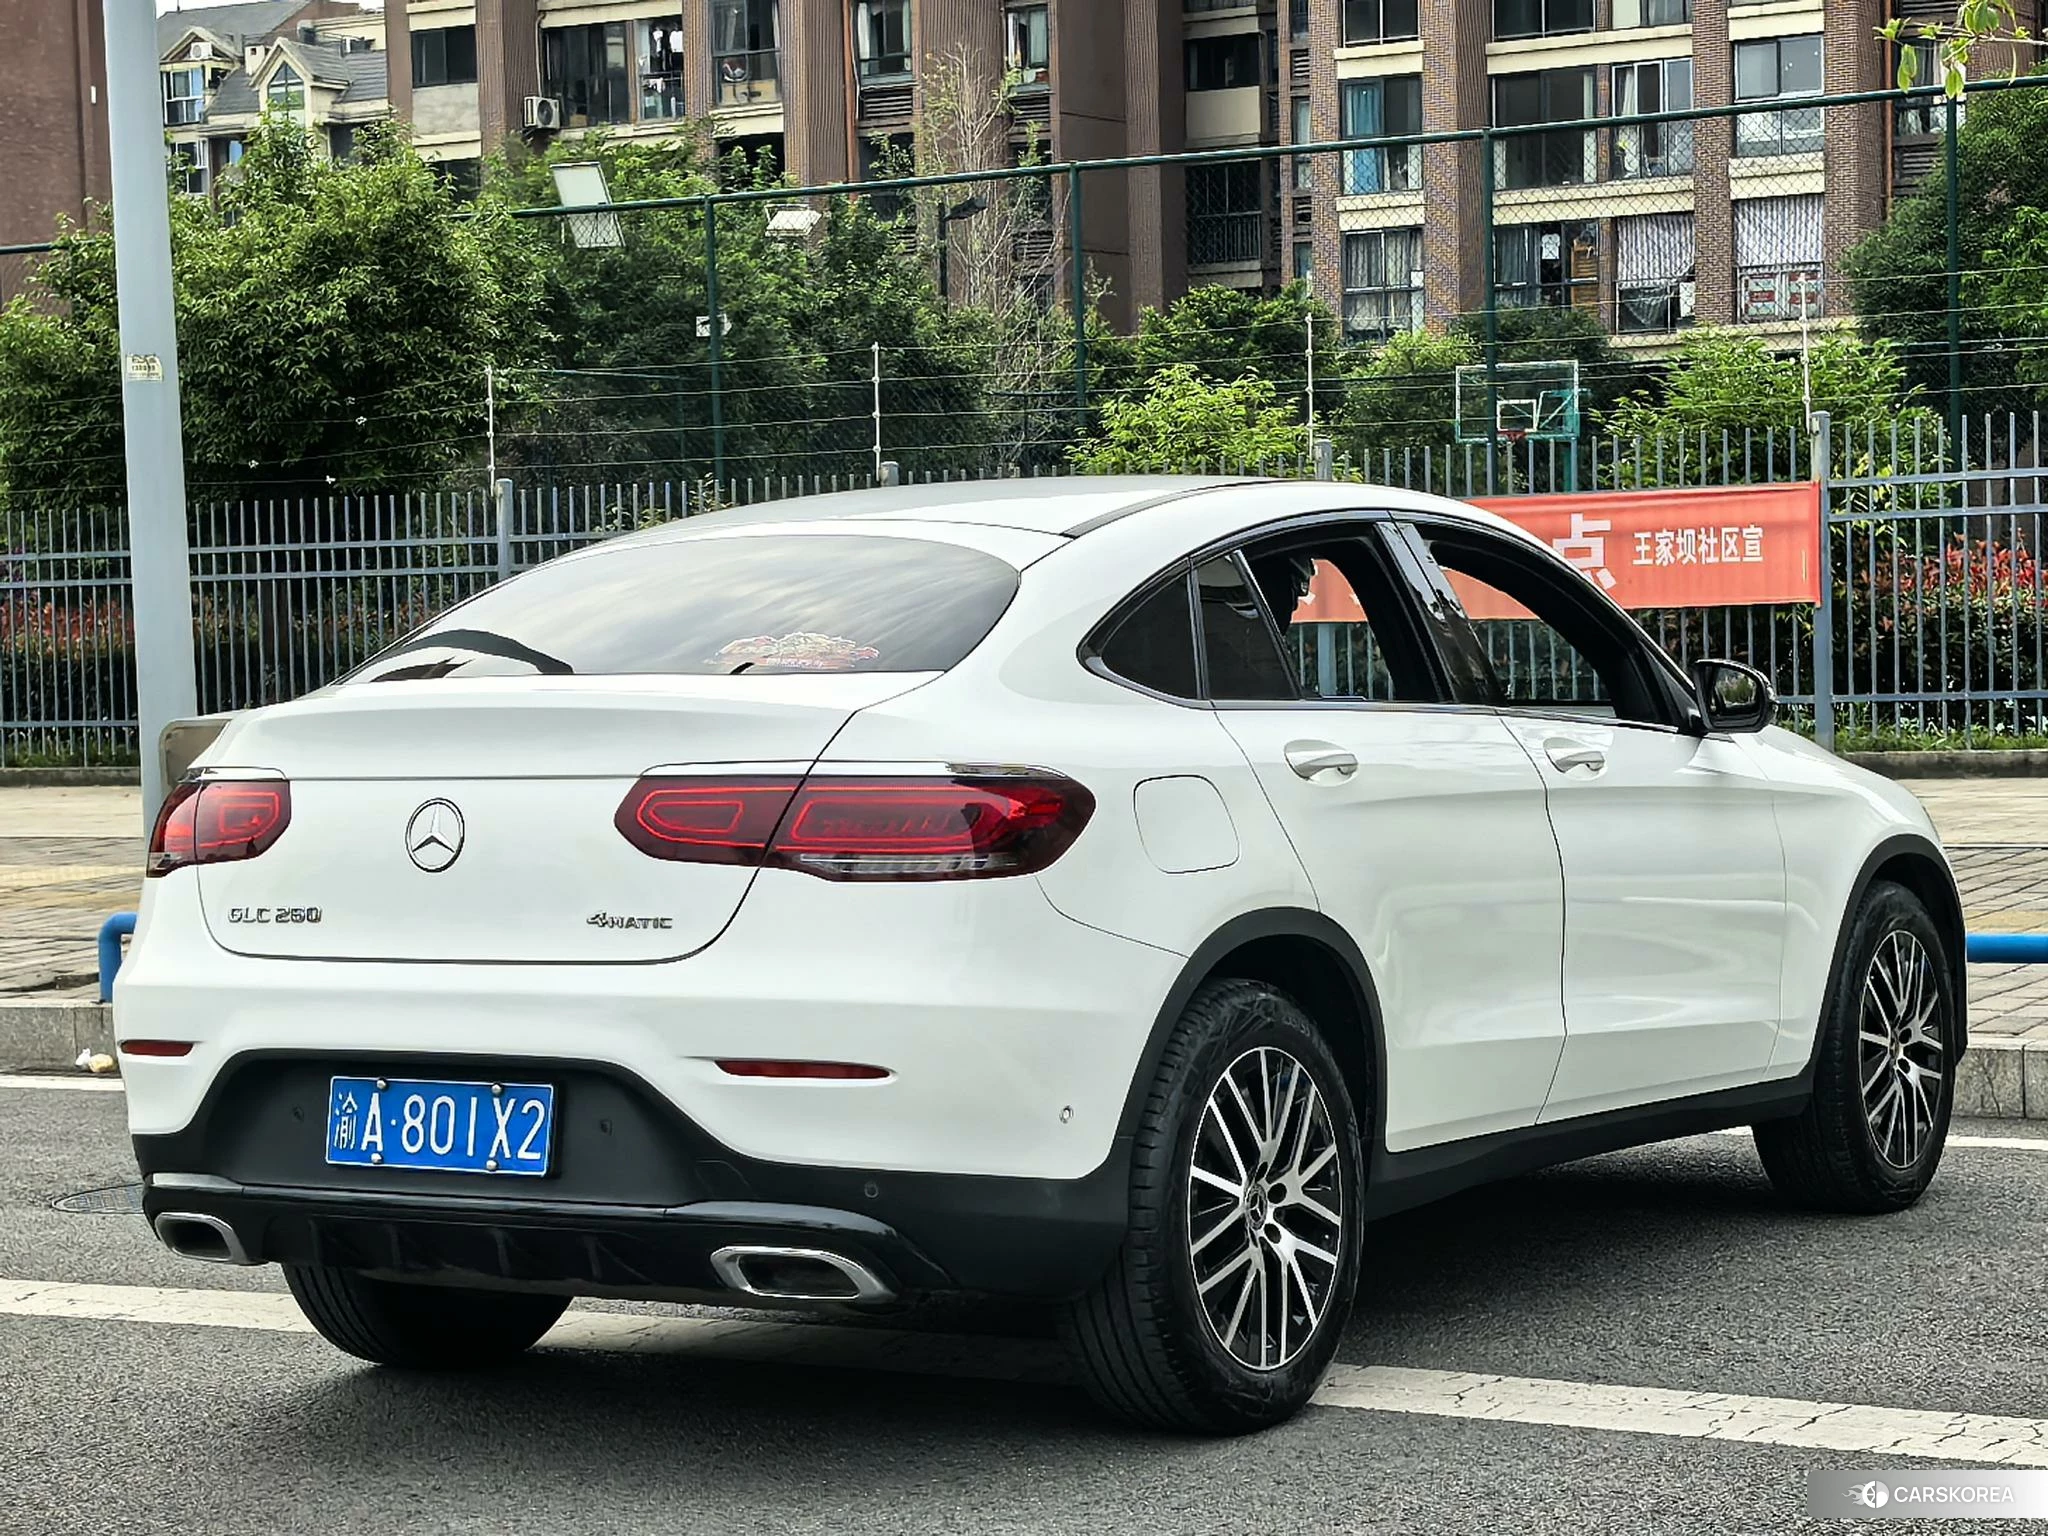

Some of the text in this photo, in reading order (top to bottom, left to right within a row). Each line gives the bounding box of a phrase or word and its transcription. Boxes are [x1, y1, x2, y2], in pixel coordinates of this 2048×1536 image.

[1632, 524, 1764, 567] 王家坝社区宣
[228, 907, 271, 923] GLC
[586, 911, 673, 929] 4MATIC
